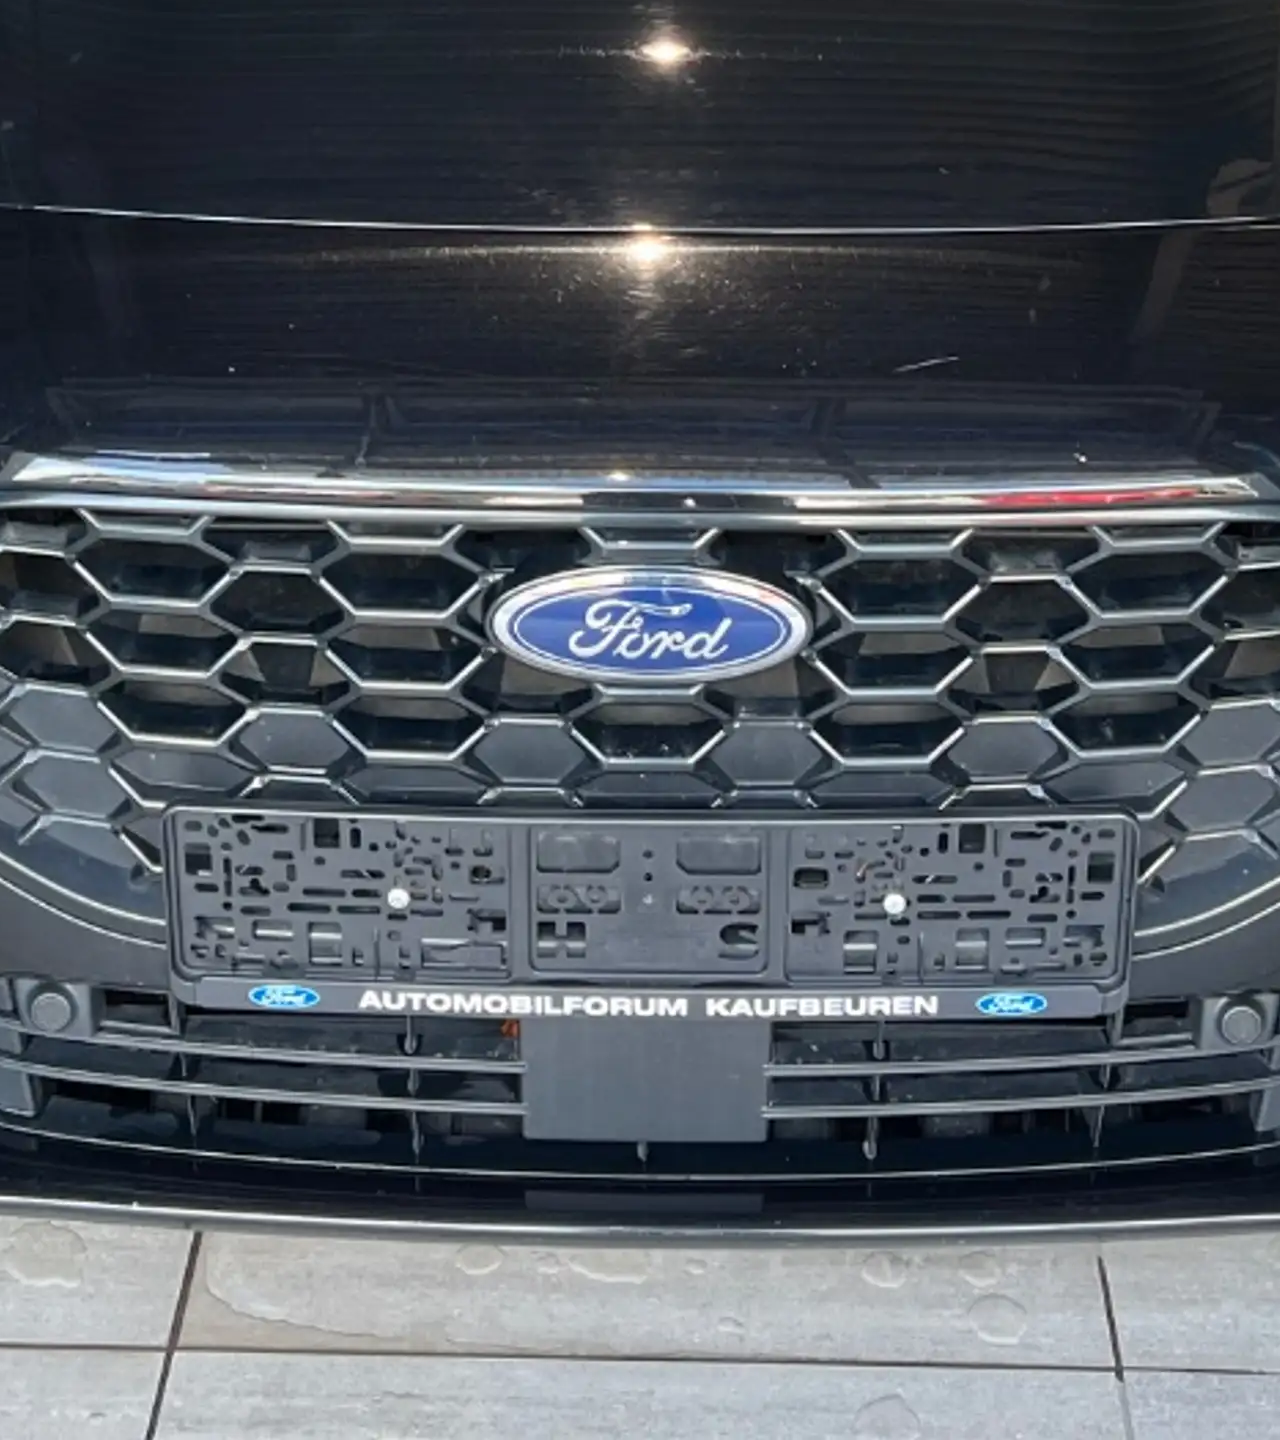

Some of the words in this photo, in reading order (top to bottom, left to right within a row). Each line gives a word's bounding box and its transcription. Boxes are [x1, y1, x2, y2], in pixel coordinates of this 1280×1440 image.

[569, 598, 733, 660] Ford
[358, 989, 689, 1018] AUTOMOBILFORUM
[705, 995, 939, 1018] KAUFBEUREN
